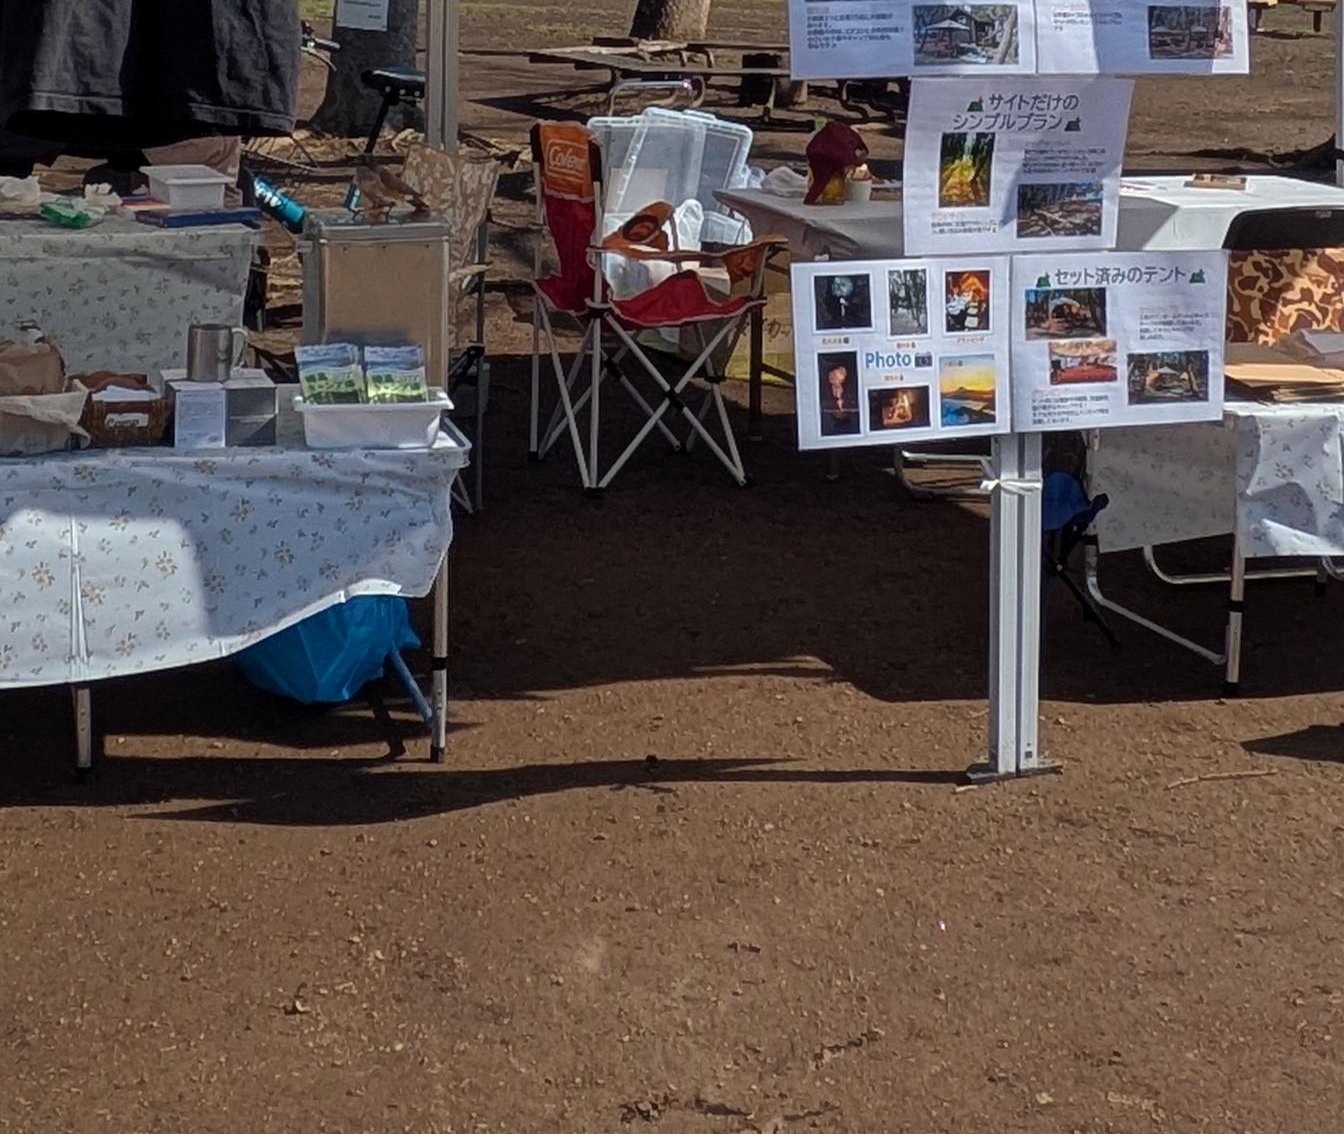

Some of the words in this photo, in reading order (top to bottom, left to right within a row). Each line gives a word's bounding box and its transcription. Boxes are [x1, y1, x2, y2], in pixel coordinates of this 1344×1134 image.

[988, 93, 1079, 112] サイトだけの
[952, 112, 1063, 131] シンプルプラン
[1054, 266, 1187, 285] セット済みのテント
[864, 350, 912, 369] Photo
